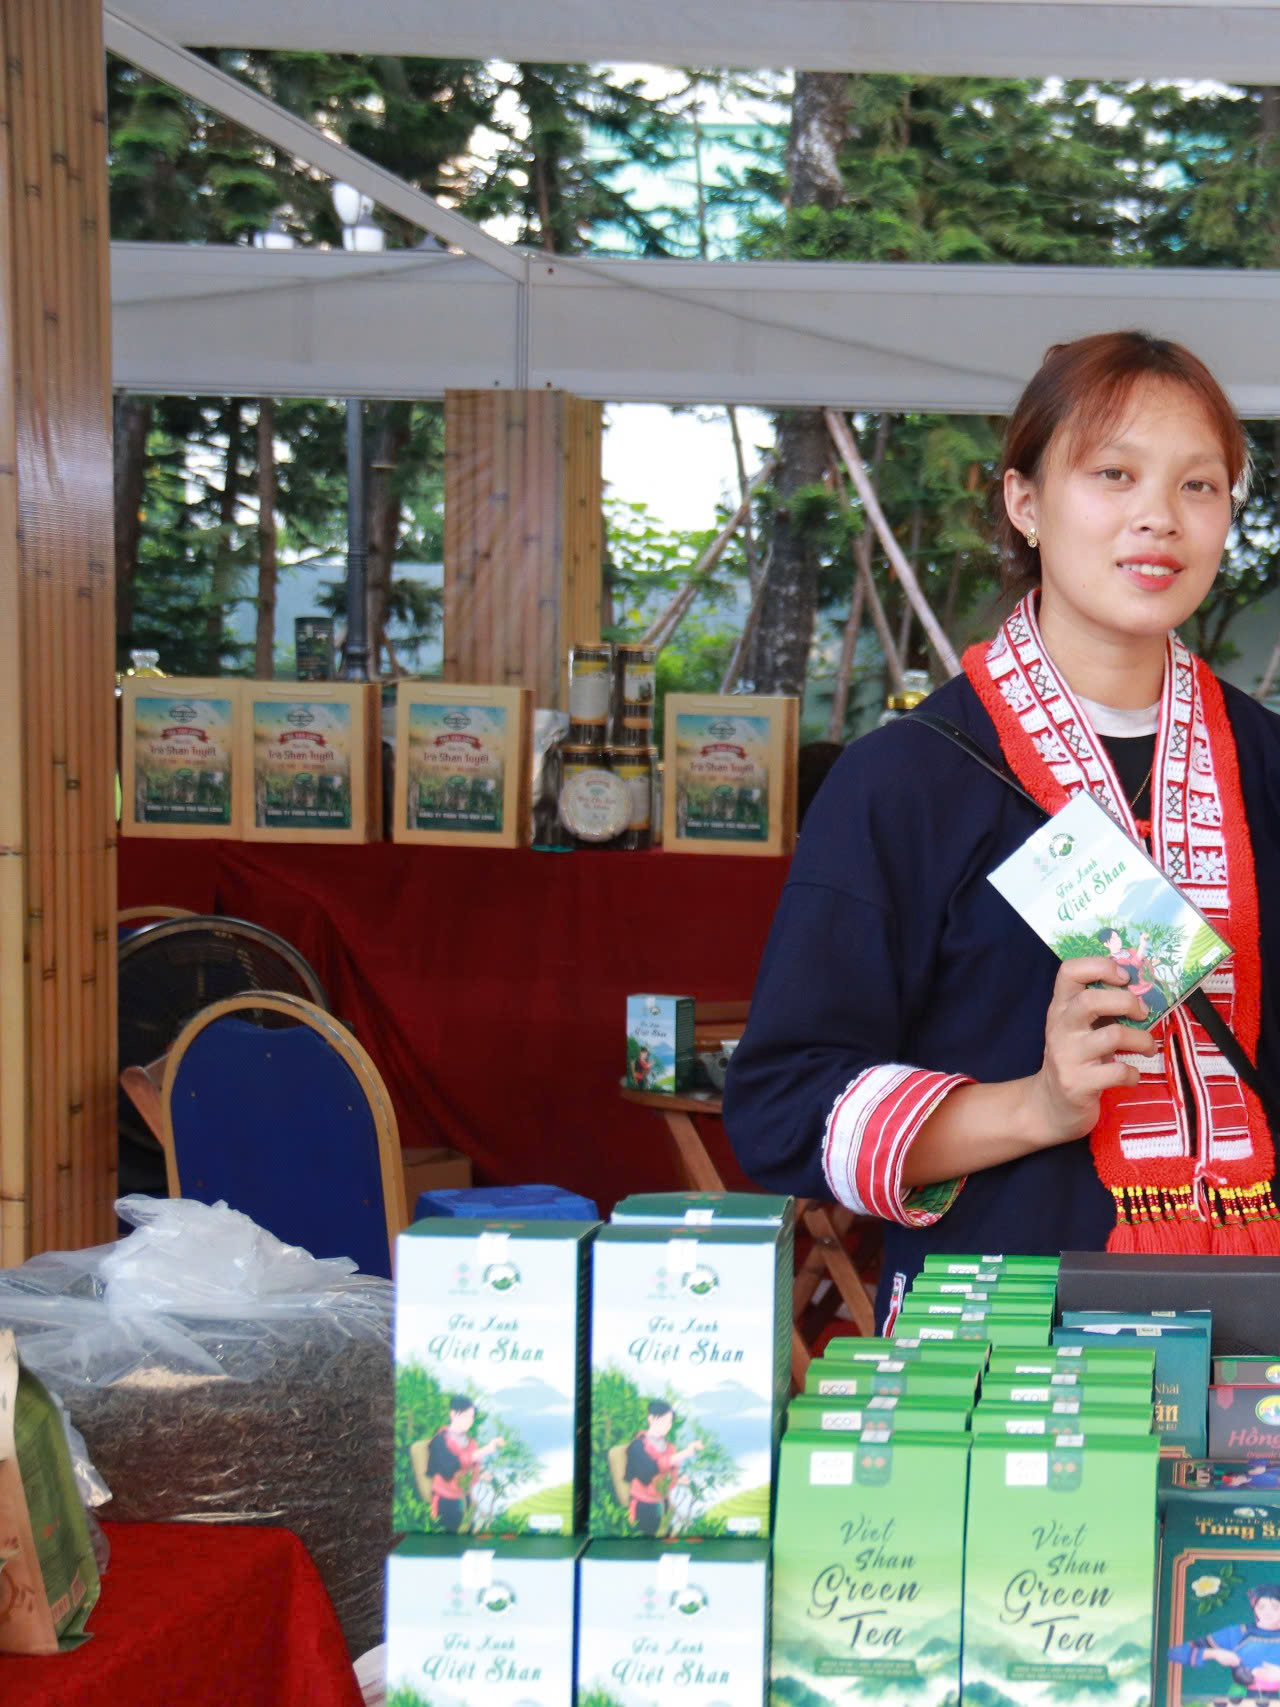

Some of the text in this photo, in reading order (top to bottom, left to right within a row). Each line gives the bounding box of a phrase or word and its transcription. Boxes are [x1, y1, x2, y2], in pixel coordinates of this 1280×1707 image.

[1057, 861, 1126, 921] Việt Shan
[428, 1335, 544, 1363] Việt Shan
[628, 1337, 744, 1364] Việt Shan
[856, 1545, 915, 1572] Shan
[1048, 1549, 1107, 1577] Shan
[806, 1564, 923, 1620] Green
[1000, 1569, 1114, 1625] Green
[838, 1609, 905, 1649] Tea
[1031, 1615, 1097, 1654] Tea
[422, 1655, 542, 1684] Việt Shan
[612, 1658, 730, 1686] Việt Shan
